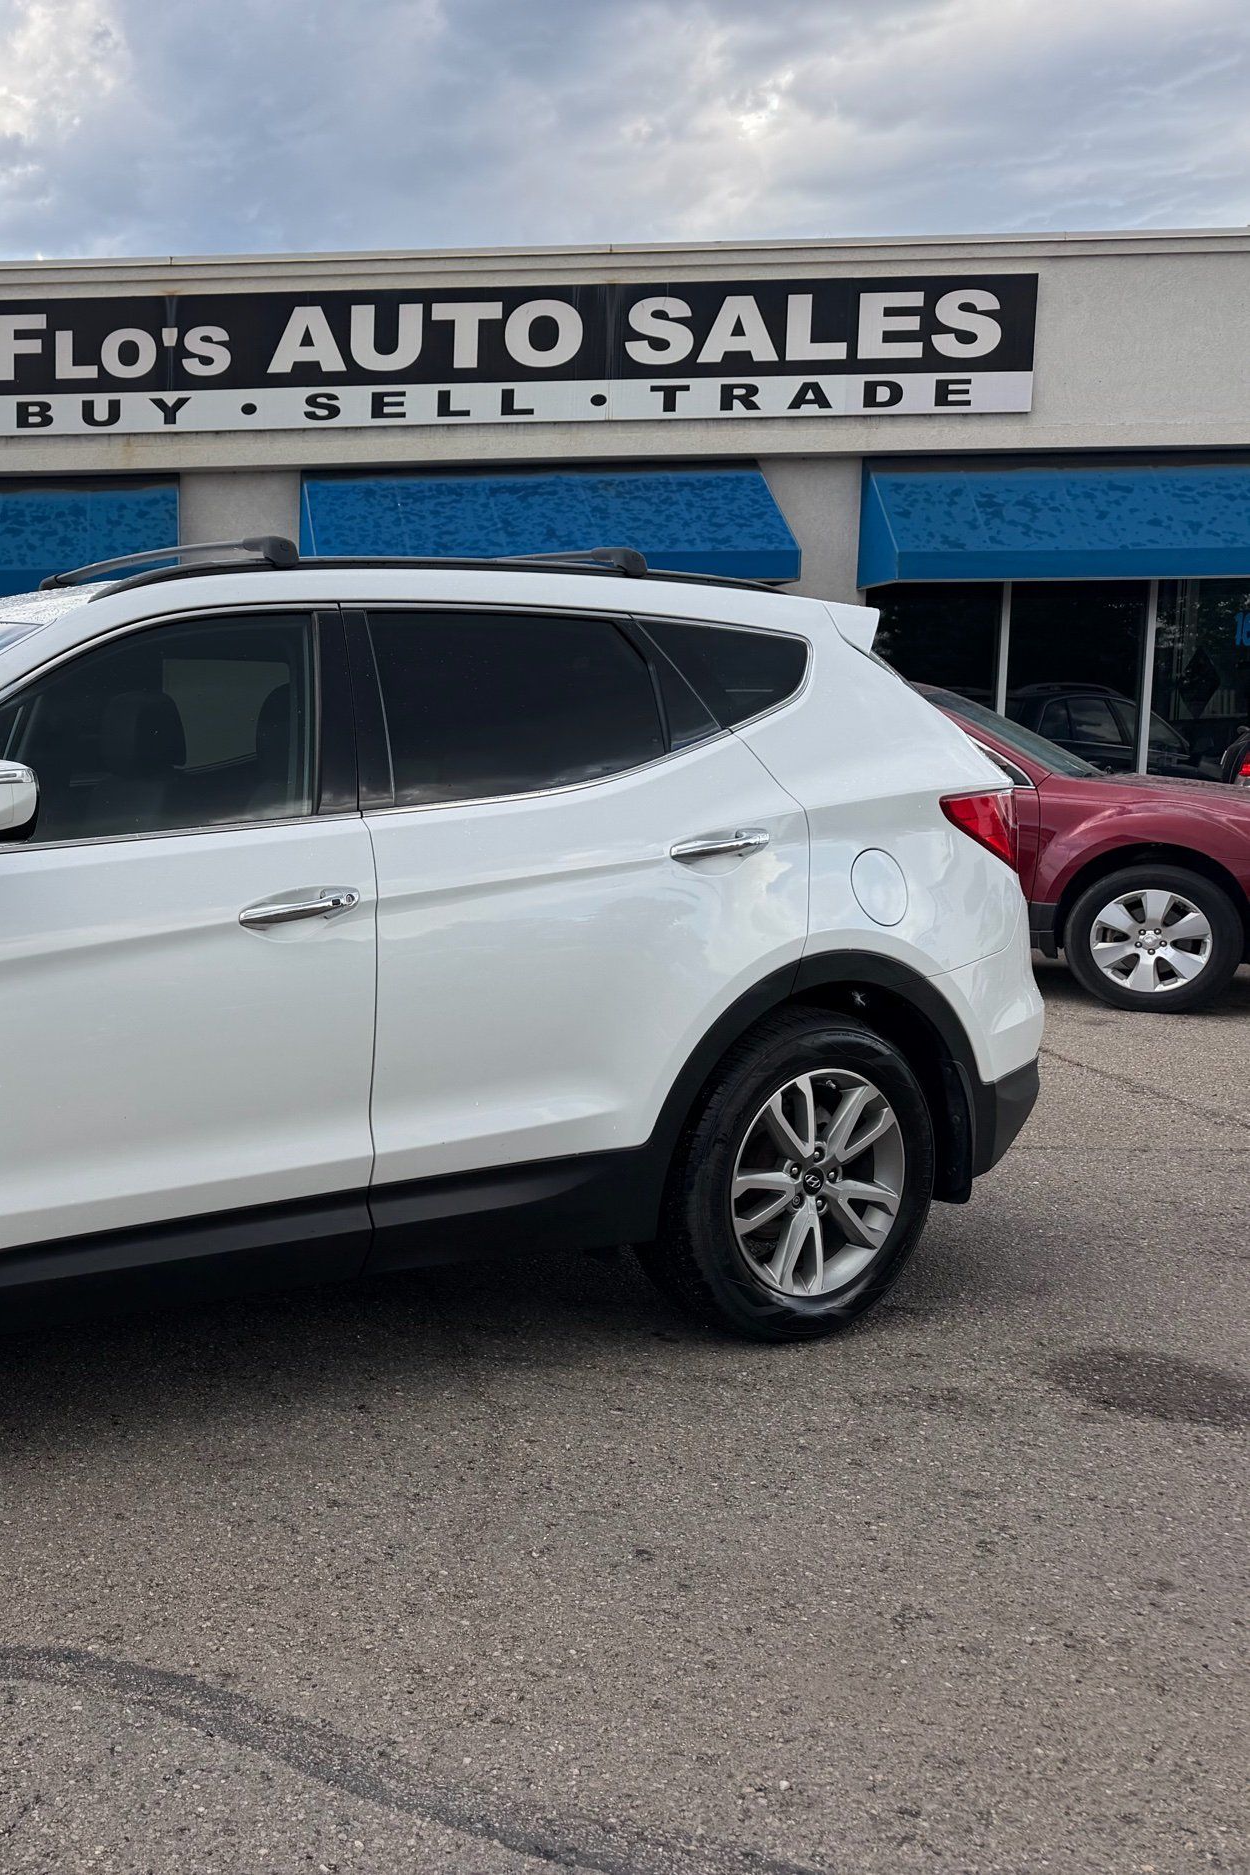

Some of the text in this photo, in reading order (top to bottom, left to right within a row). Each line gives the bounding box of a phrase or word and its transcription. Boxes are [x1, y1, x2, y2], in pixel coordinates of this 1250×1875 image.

[266, 299, 584, 374] AUTO
[624, 288, 1002, 365] SALES
[16, 378, 972, 429] BUY SELL TRADE
